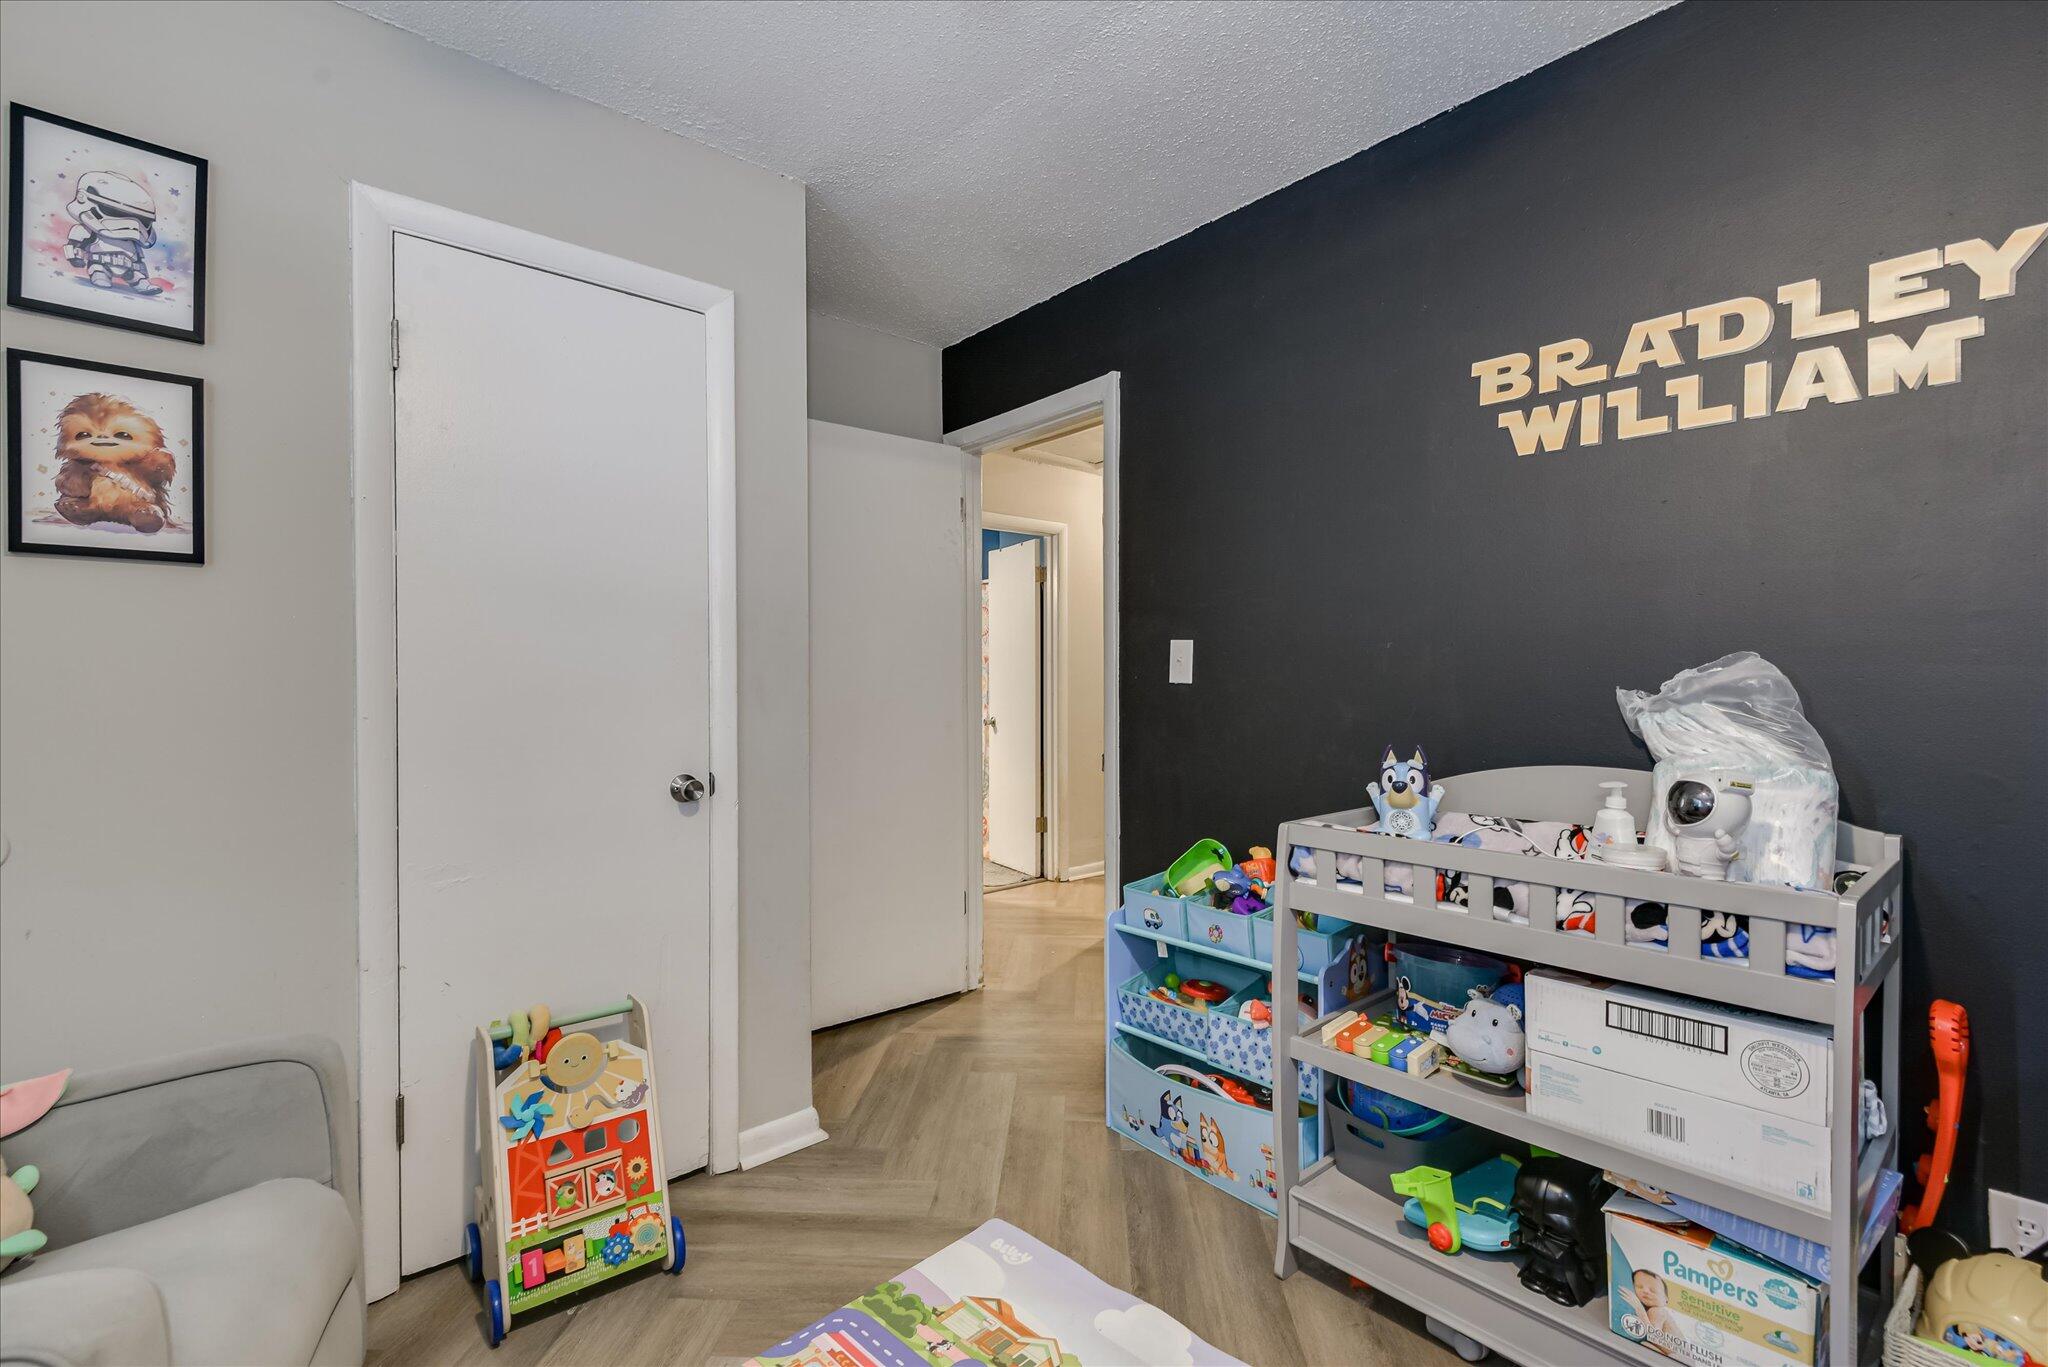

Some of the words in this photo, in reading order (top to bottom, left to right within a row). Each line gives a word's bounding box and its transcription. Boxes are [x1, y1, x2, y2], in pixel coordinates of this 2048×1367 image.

[1471, 223, 2048, 406] BRADLEY
[1498, 315, 1985, 456] WILLIAM
[528, 1257, 538, 1277] 1
[1663, 1250, 1759, 1308] Pampers
[1681, 1290, 1741, 1322] Sensitive
[1647, 1325, 1664, 1338] DO
[1665, 1334, 1688, 1349] NOT
[1690, 1344, 1723, 1365] FLUSH
